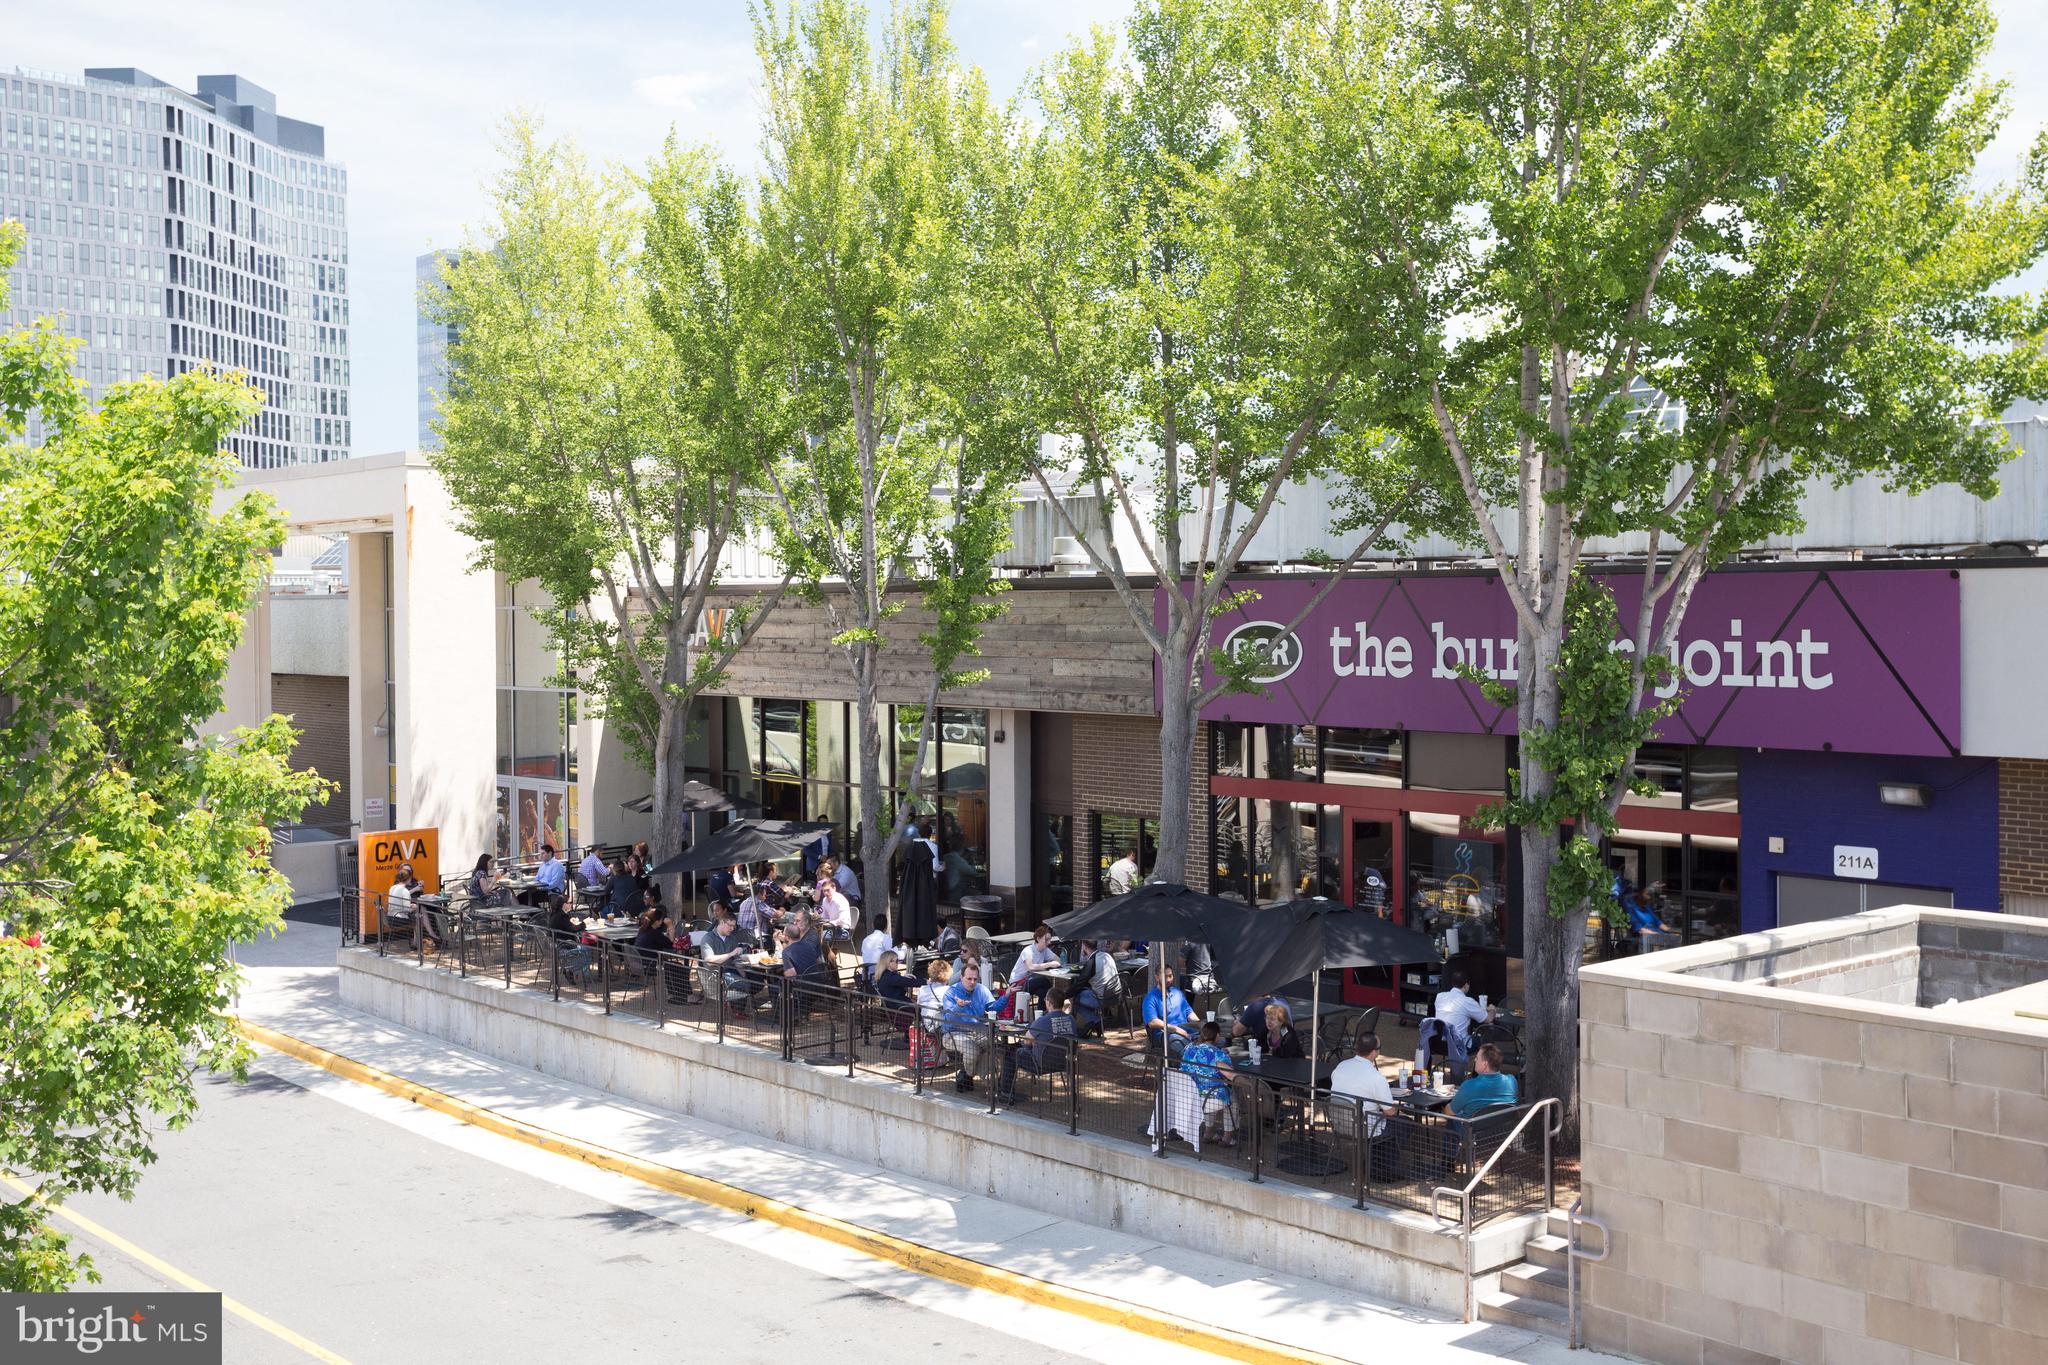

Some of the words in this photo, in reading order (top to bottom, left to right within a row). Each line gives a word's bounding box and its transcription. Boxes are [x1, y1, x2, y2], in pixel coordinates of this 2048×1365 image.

[686, 608, 740, 647] AVA
[1329, 621, 1414, 678] the
[1431, 621, 1636, 684] bur
[1653, 618, 1834, 699] joint
[375, 838, 427, 863] CAVA
[1838, 854, 1874, 870] 211A
